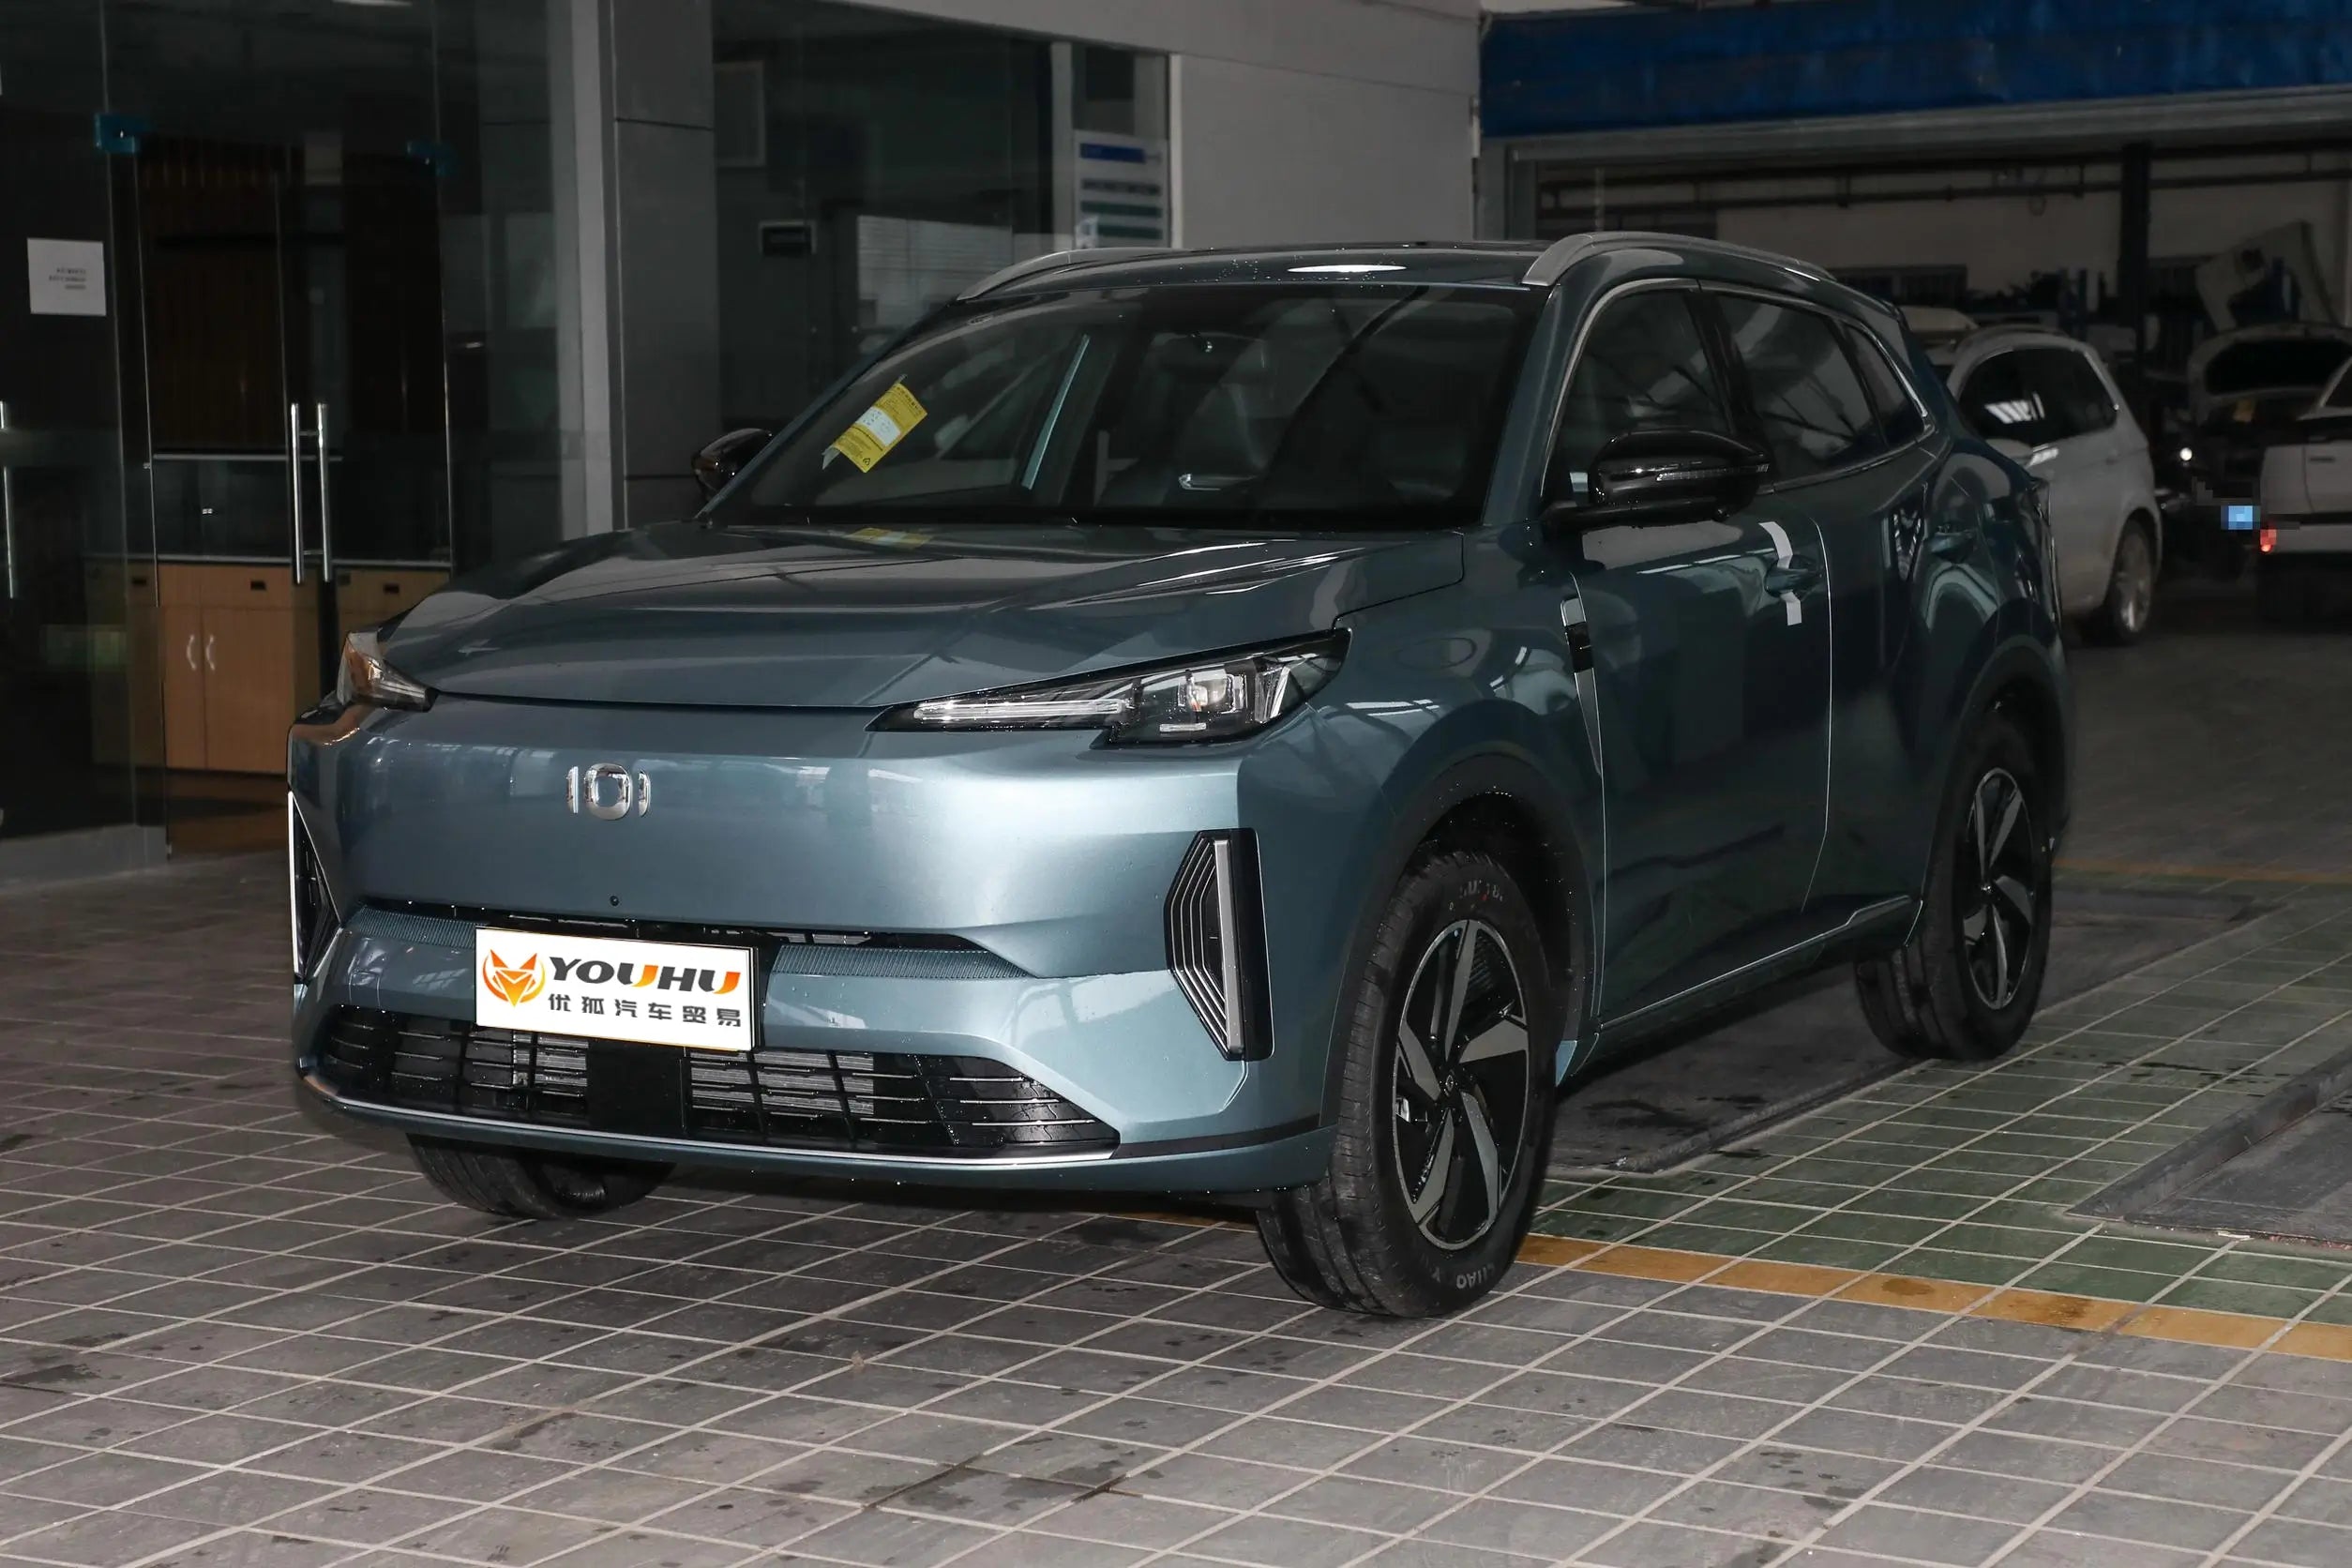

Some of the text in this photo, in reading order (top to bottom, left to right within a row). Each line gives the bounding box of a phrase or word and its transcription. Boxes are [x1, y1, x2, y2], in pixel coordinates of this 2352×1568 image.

[550, 957, 741, 994] YOUHU
[548, 993, 742, 1027] 优狐汽车贸易
